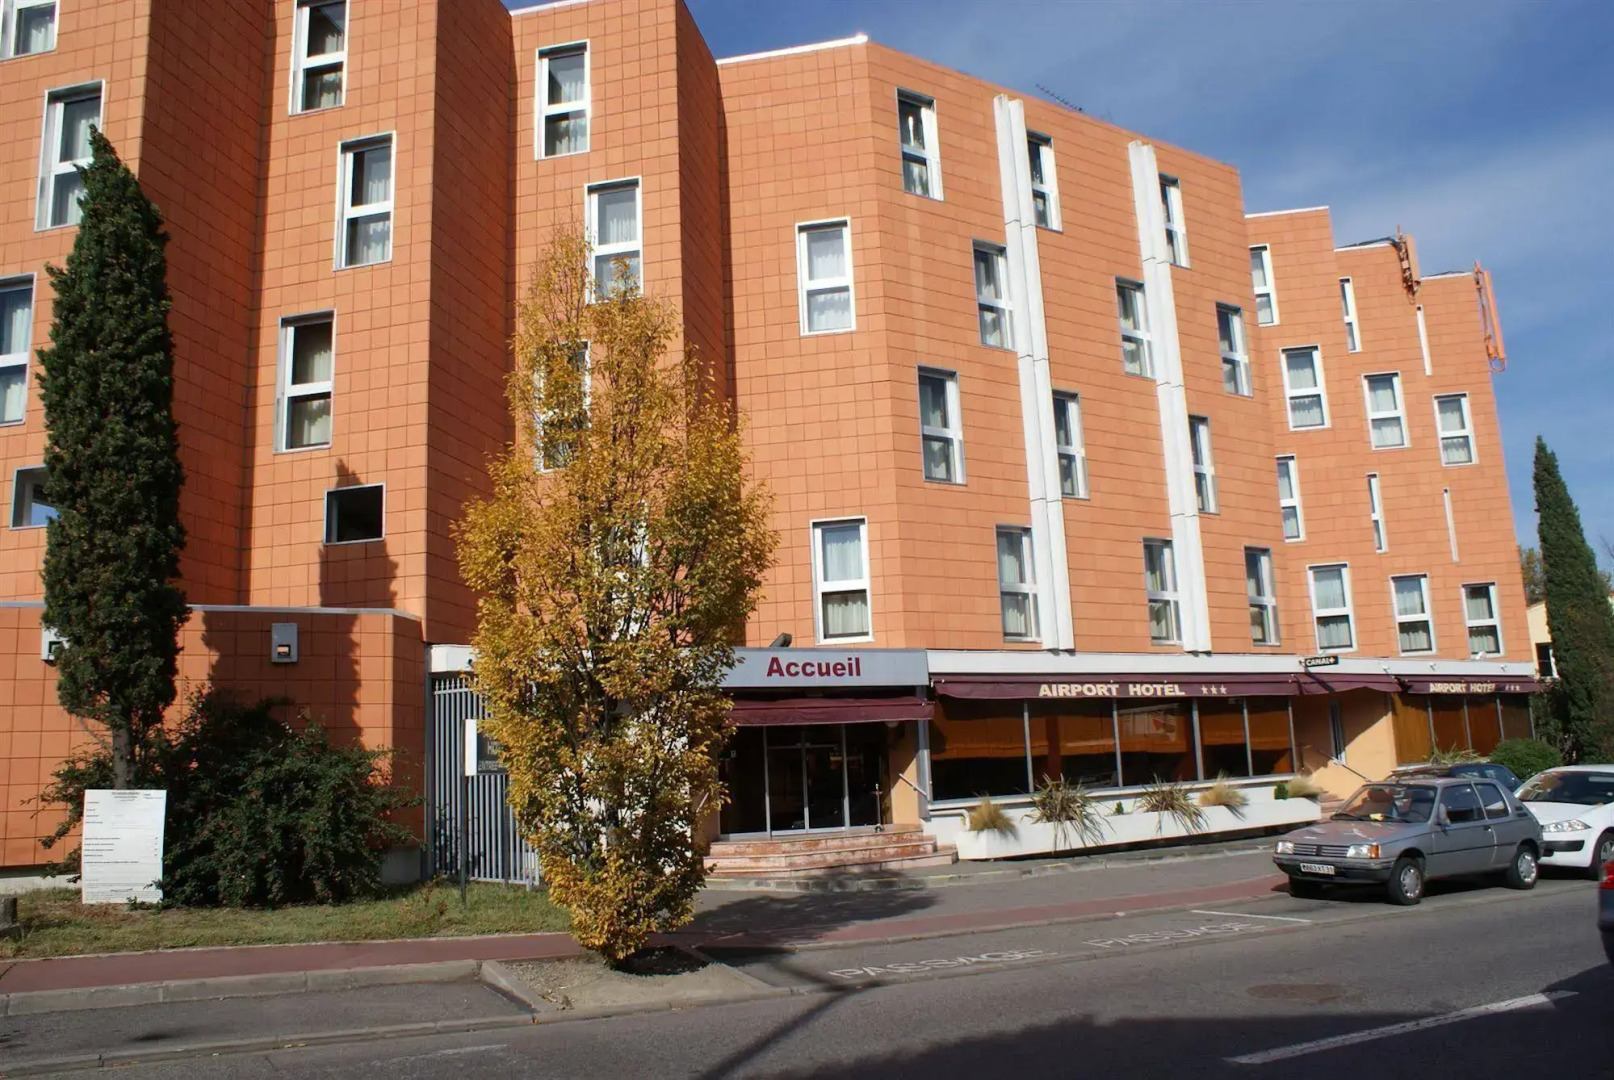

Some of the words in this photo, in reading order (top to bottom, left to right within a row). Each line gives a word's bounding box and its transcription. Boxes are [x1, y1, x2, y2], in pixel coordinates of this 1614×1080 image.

[766, 656, 861, 677] Accueil
[1306, 656, 1335, 667] CANAL+
[1038, 683, 1120, 697] AIRPORT
[1128, 683, 1186, 697] HOTEL
[1429, 682, 1467, 693] AIRPORT
[828, 950, 1059, 979] PASSAGE
